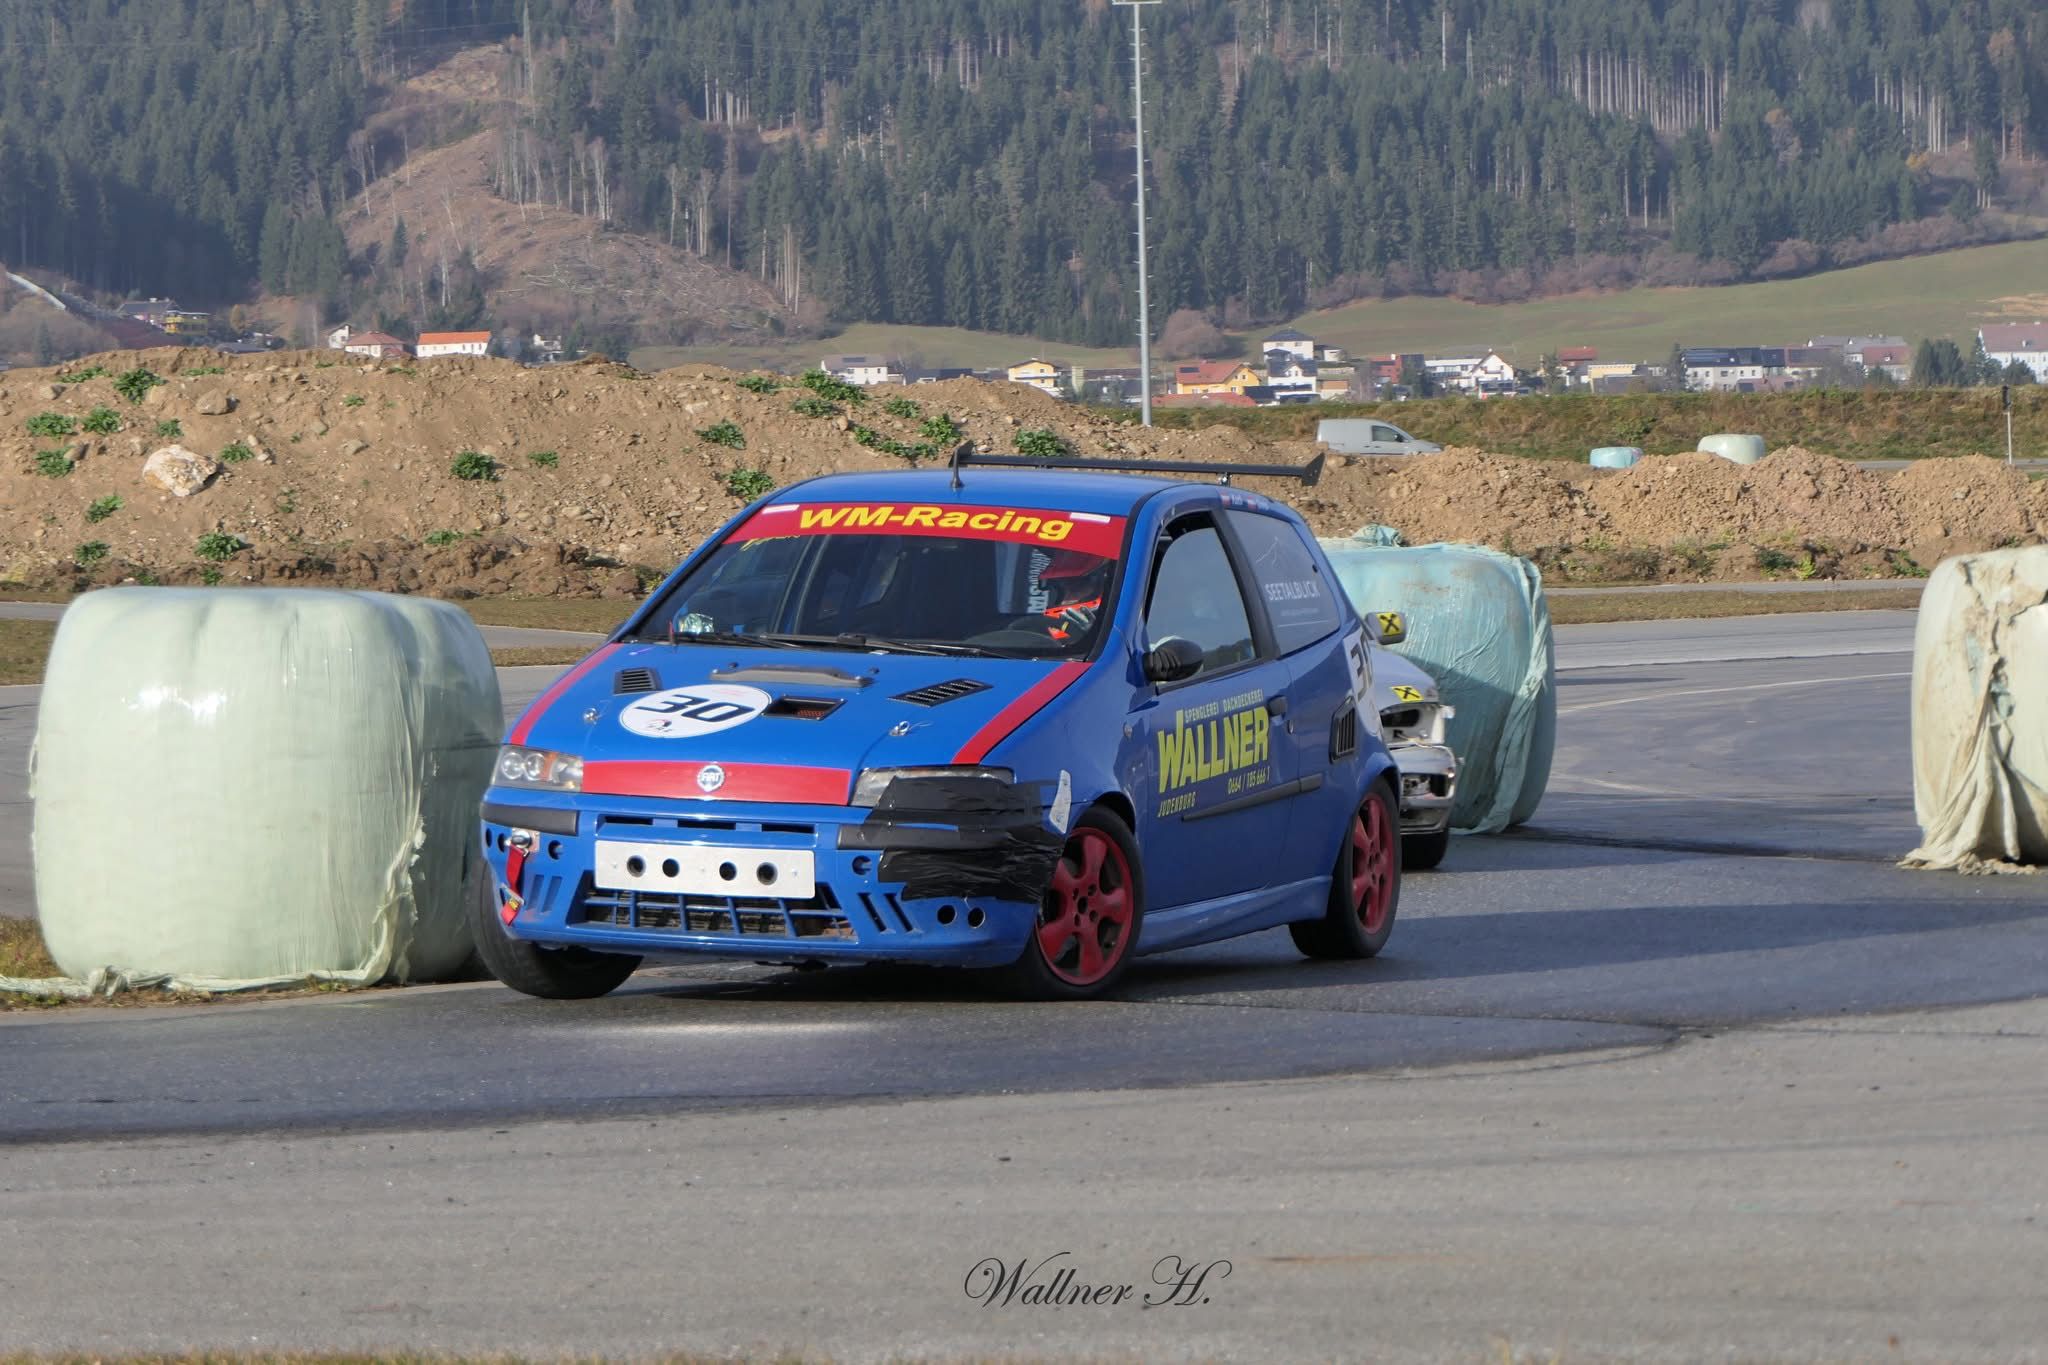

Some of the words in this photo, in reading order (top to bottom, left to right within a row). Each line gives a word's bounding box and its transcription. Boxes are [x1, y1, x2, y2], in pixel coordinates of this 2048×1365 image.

[799, 506, 1074, 541] WM-Racing
[1264, 581, 1320, 601] SEETALBLICK
[636, 693, 755, 722] 30
[1185, 703, 1219, 723] SPENGLEREI
[1223, 688, 1264, 712] DACHDECKEREI
[1157, 706, 1270, 793] WALLNER
[701, 772, 720, 782] FIAT
